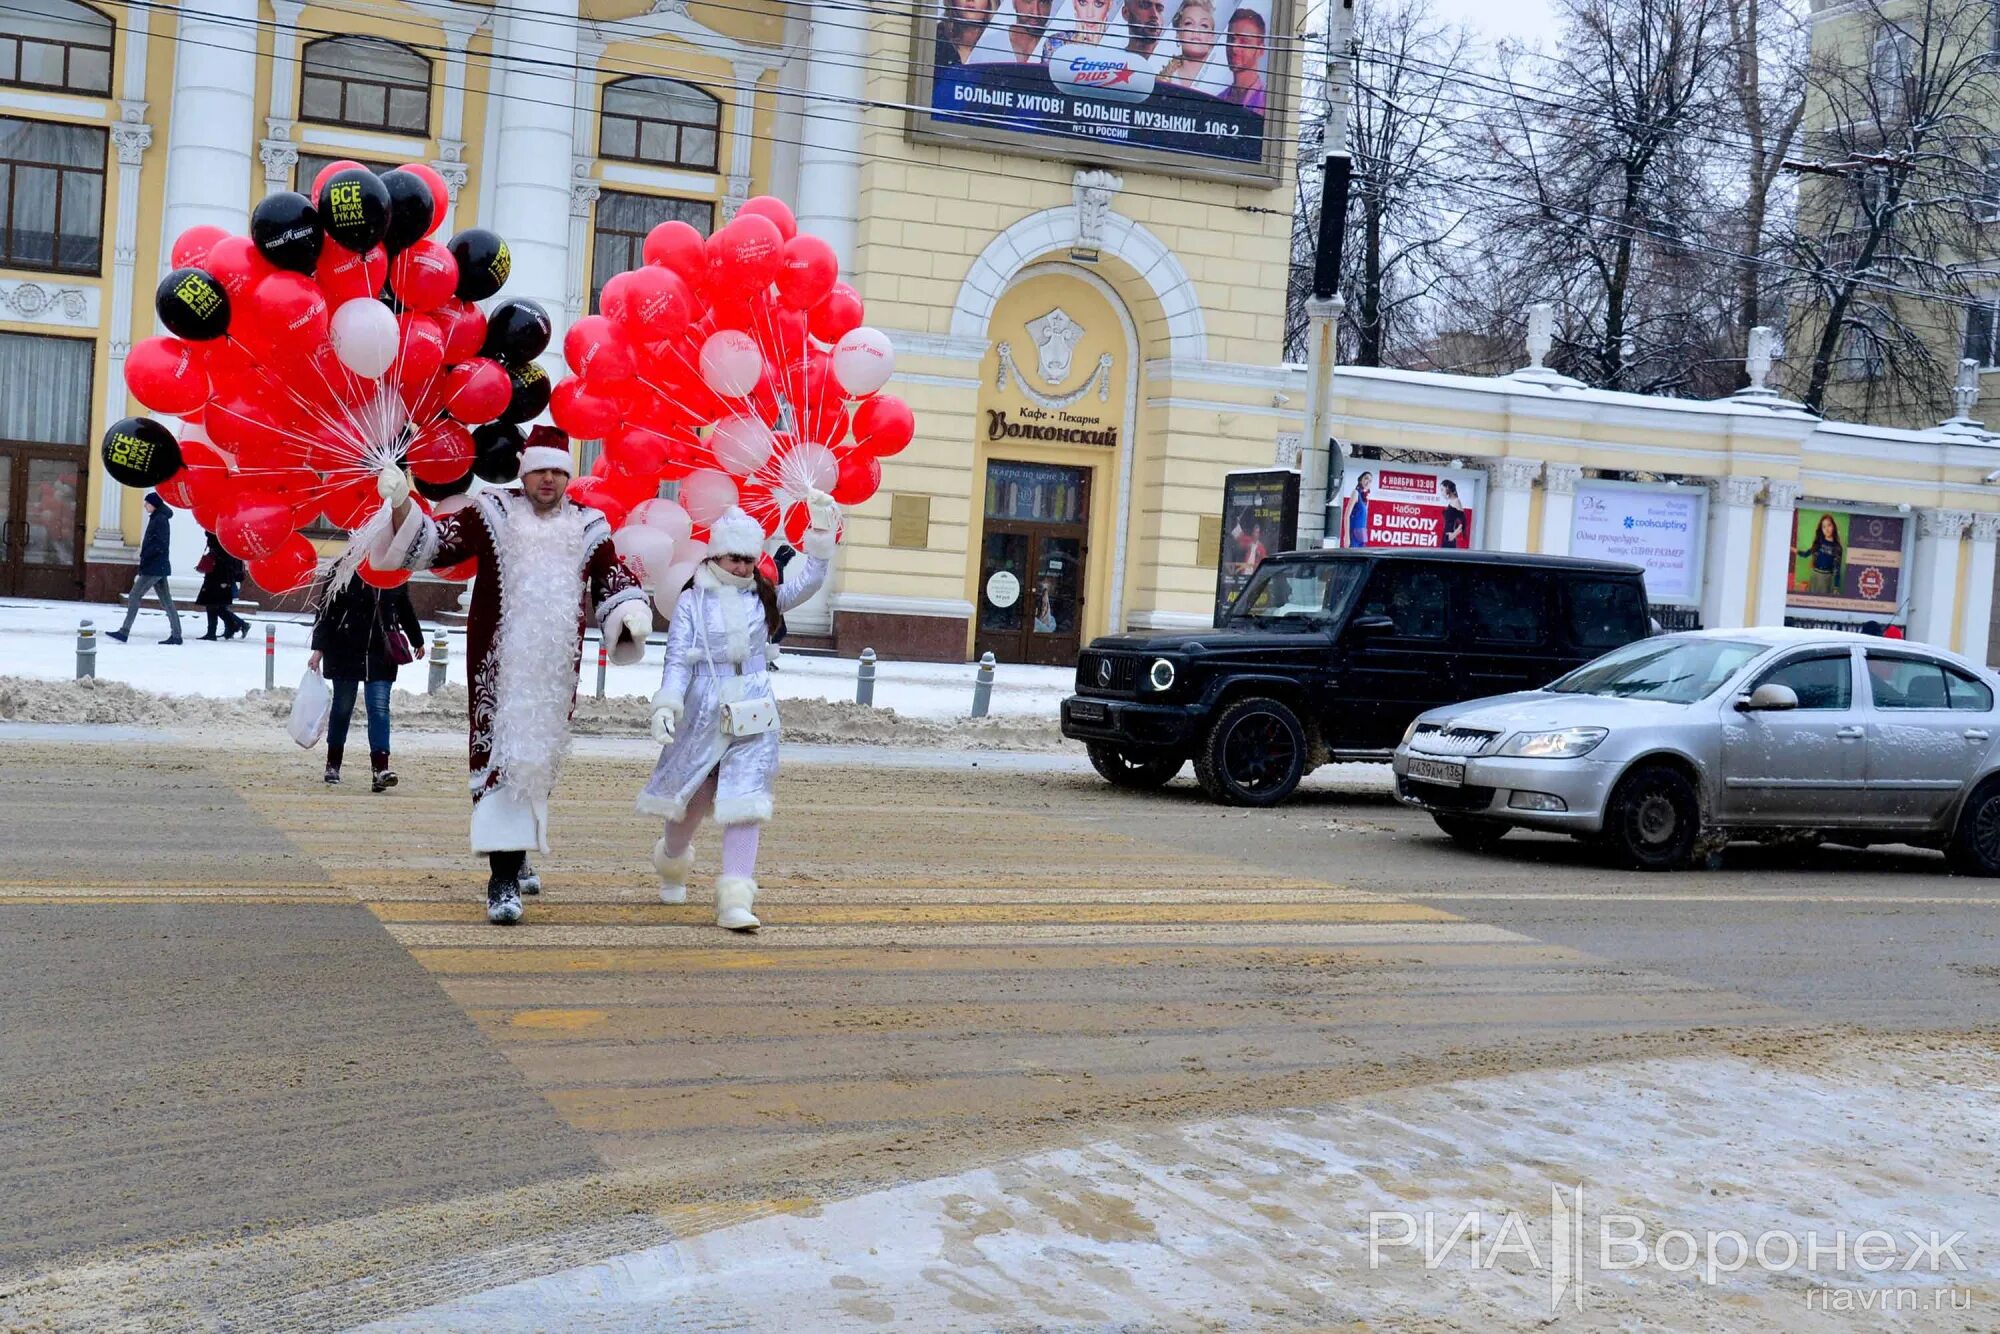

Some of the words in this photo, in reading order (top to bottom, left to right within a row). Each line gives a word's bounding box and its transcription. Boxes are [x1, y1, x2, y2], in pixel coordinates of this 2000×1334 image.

[1070, 57, 1124, 71] Europa
[954, 85, 1014, 107] БОЛЬШЕ
[1017, 94, 1065, 114] ХИТОВ!
[1073, 102, 1131, 124] БОЛЬШЕ
[1134, 110, 1196, 132] МУЗЫКИ!
[1204, 120, 1239, 137] 1062
[1096, 126, 1129, 139] РОССИИ
[330, 185, 361, 206] ВСЕ
[338, 202, 363, 212] ТВОИХ
[333, 210, 364, 222] РУКАХ
[177, 275, 208, 304] ВСЕ
[195, 290, 220, 317] РУКАХ
[1020, 407, 1048, 422] Кафе
[1058, 411, 1100, 427] Пекарня
[986, 408, 1118, 447] Волконский
[111, 433, 135, 466] ВСЕ
[134, 440, 150, 471] РУКАХ
[1382, 476, 1387, 484] 4
[1388, 477, 1414, 487] НОЯБРЯ
[1416, 480, 1435, 489] 13:00
[1392, 503, 1421, 515] Набор
[1373, 514, 1383, 526] В
[1386, 515, 1438, 531] ШКОЛУ
[1635, 518, 1687, 532] coolsculpting
[1369, 530, 1438, 547] МОДЕЛЕЙ
